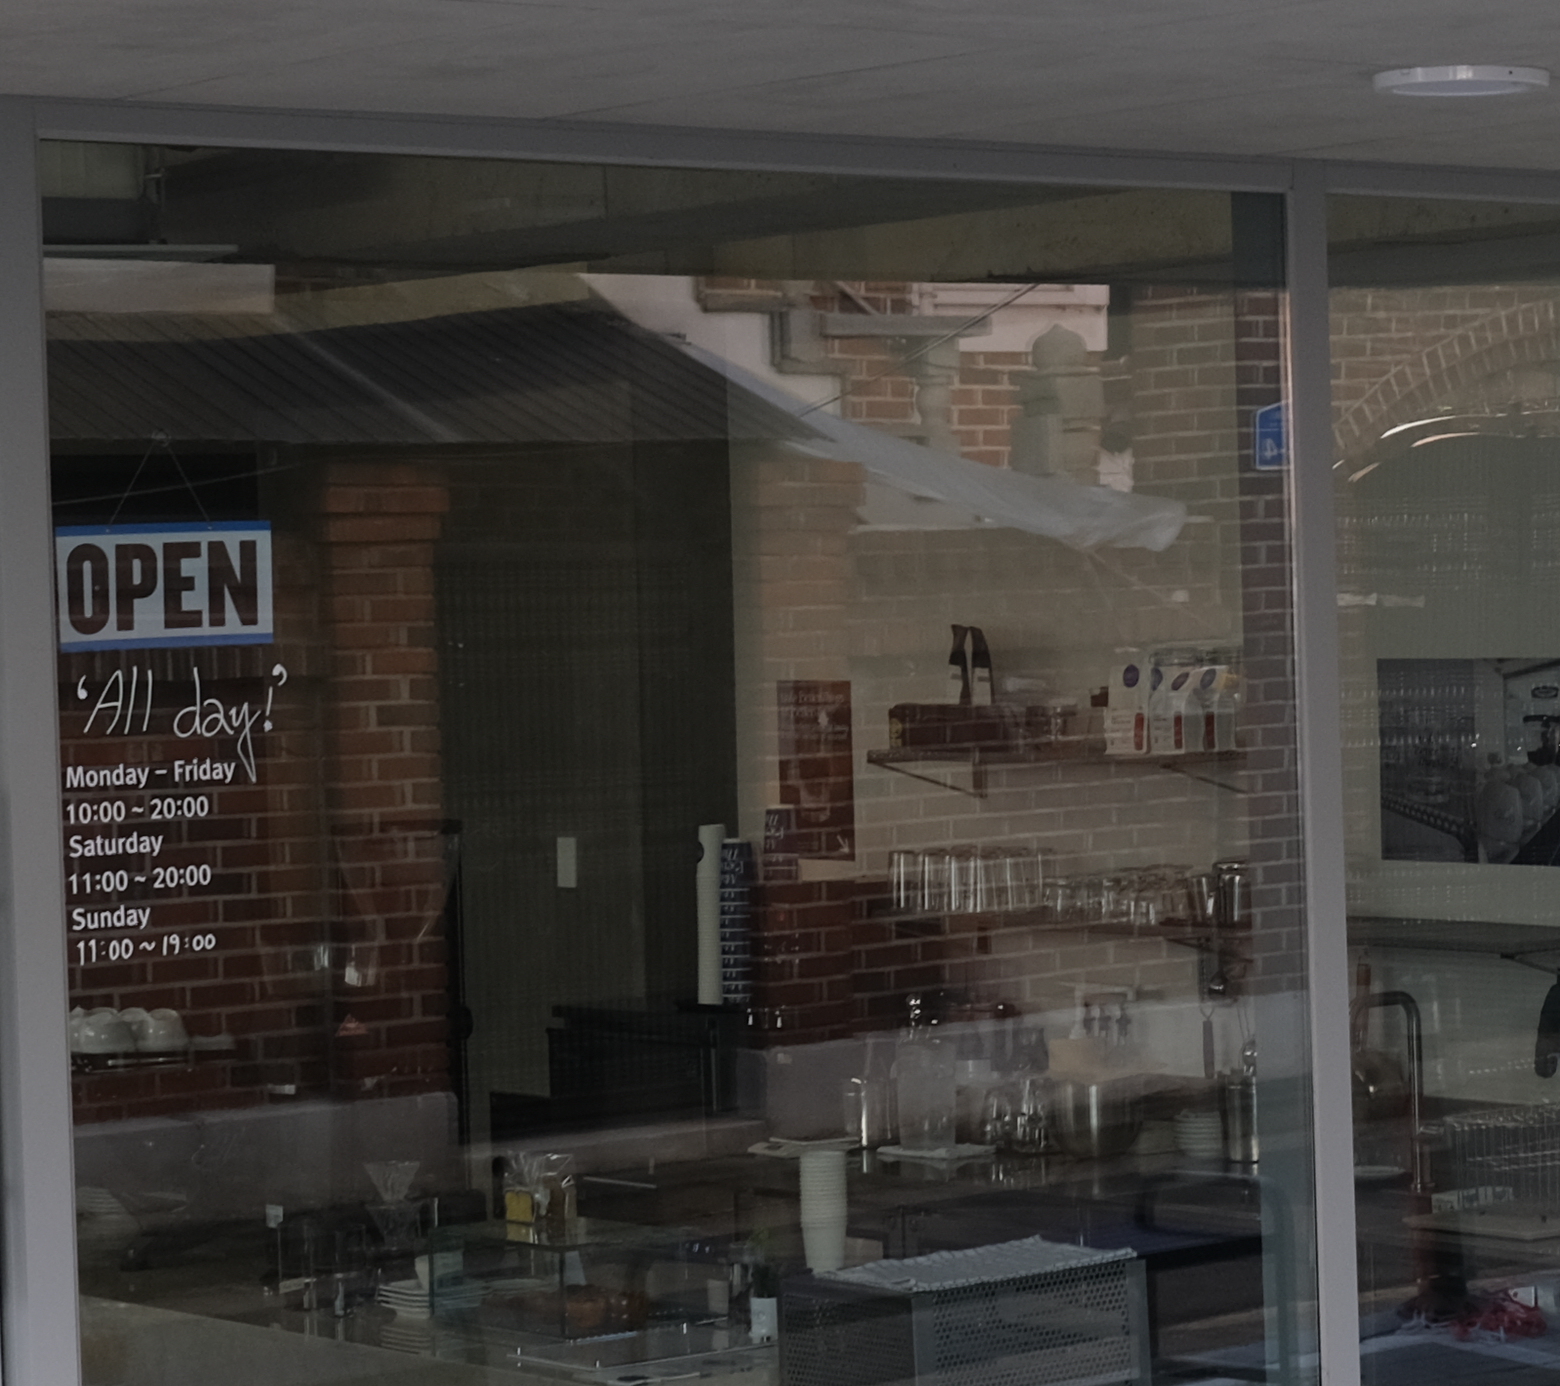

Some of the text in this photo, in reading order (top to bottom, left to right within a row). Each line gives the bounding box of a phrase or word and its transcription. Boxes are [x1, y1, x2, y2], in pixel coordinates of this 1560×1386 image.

[66, 540, 258, 635] OPEN
[66, 763, 149, 788] Monday
[173, 757, 236, 784] Friday
[66, 800, 126, 825] 10:00
[150, 796, 209, 820] 20:00
[69, 831, 164, 858] Saturday
[68, 870, 128, 894] 11:00
[152, 864, 212, 889] 20:00
[72, 904, 151, 931] Sunday
[76, 938, 134, 966] 11:00
[162, 933, 216, 956] 19:00
